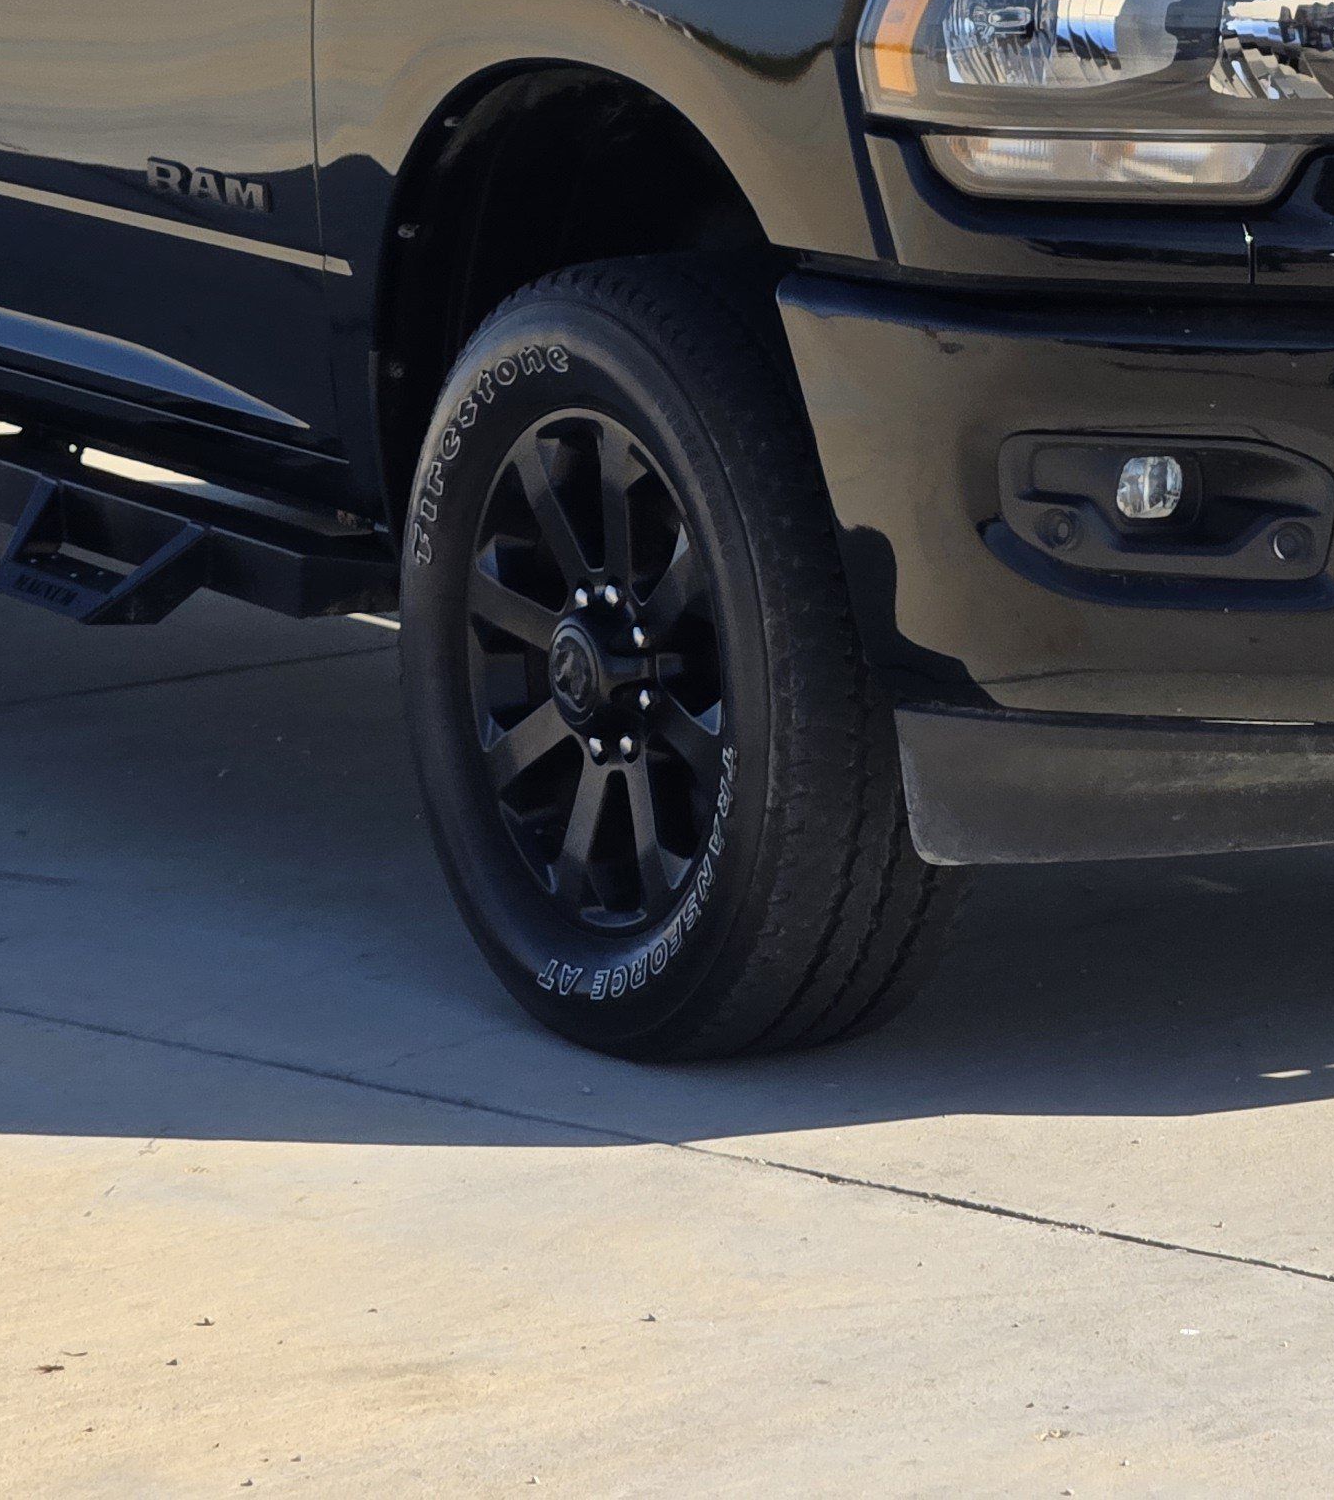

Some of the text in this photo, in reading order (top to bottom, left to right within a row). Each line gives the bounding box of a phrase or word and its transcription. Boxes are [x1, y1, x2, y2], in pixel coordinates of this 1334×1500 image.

[147, 156, 273, 213] RAM
[536, 745, 737, 1000] TRANSFORCE AT
